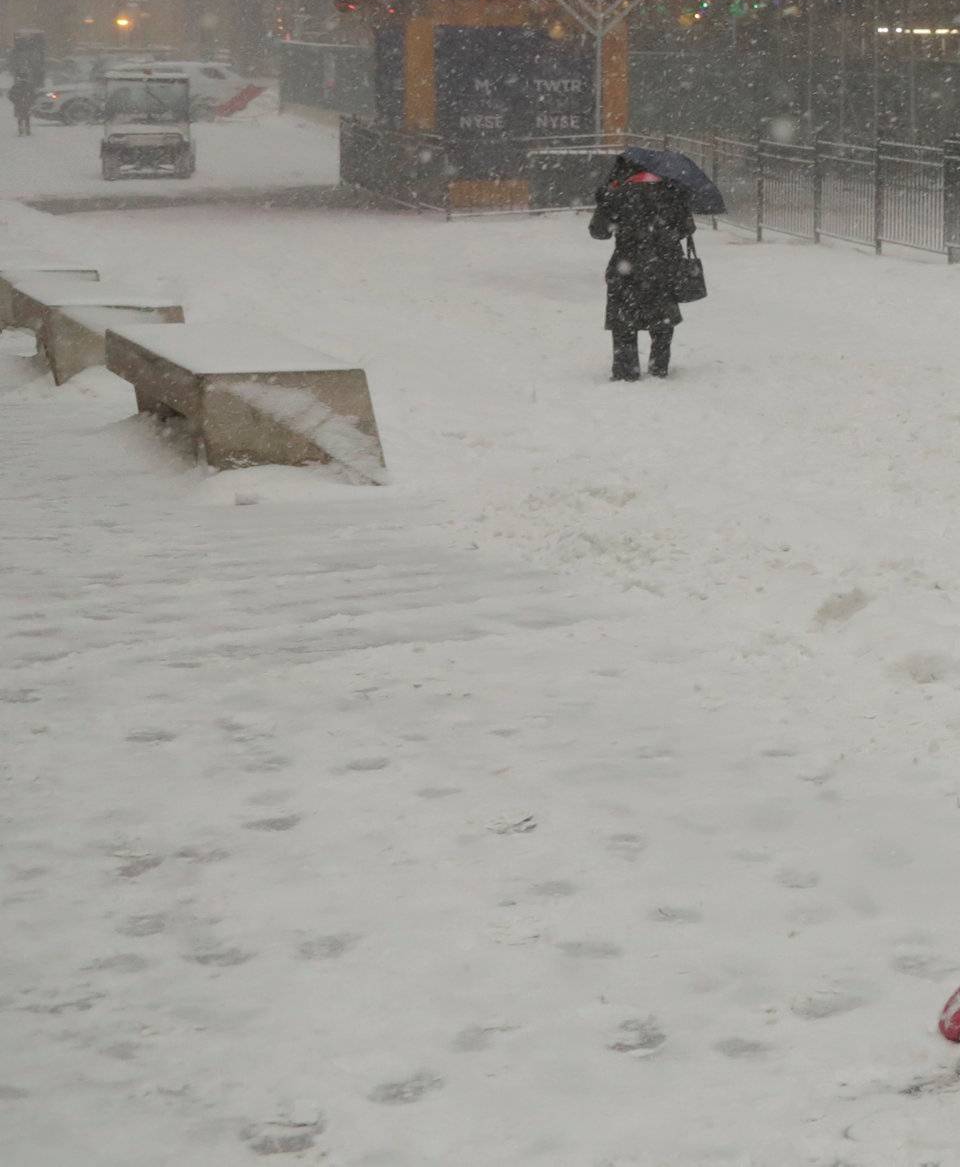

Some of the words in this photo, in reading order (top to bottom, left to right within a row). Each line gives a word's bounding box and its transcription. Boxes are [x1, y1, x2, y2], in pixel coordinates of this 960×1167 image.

[533, 79, 582, 92] TWTR
[459, 115, 504, 129] NYSE
[535, 115, 580, 129] NYSE
